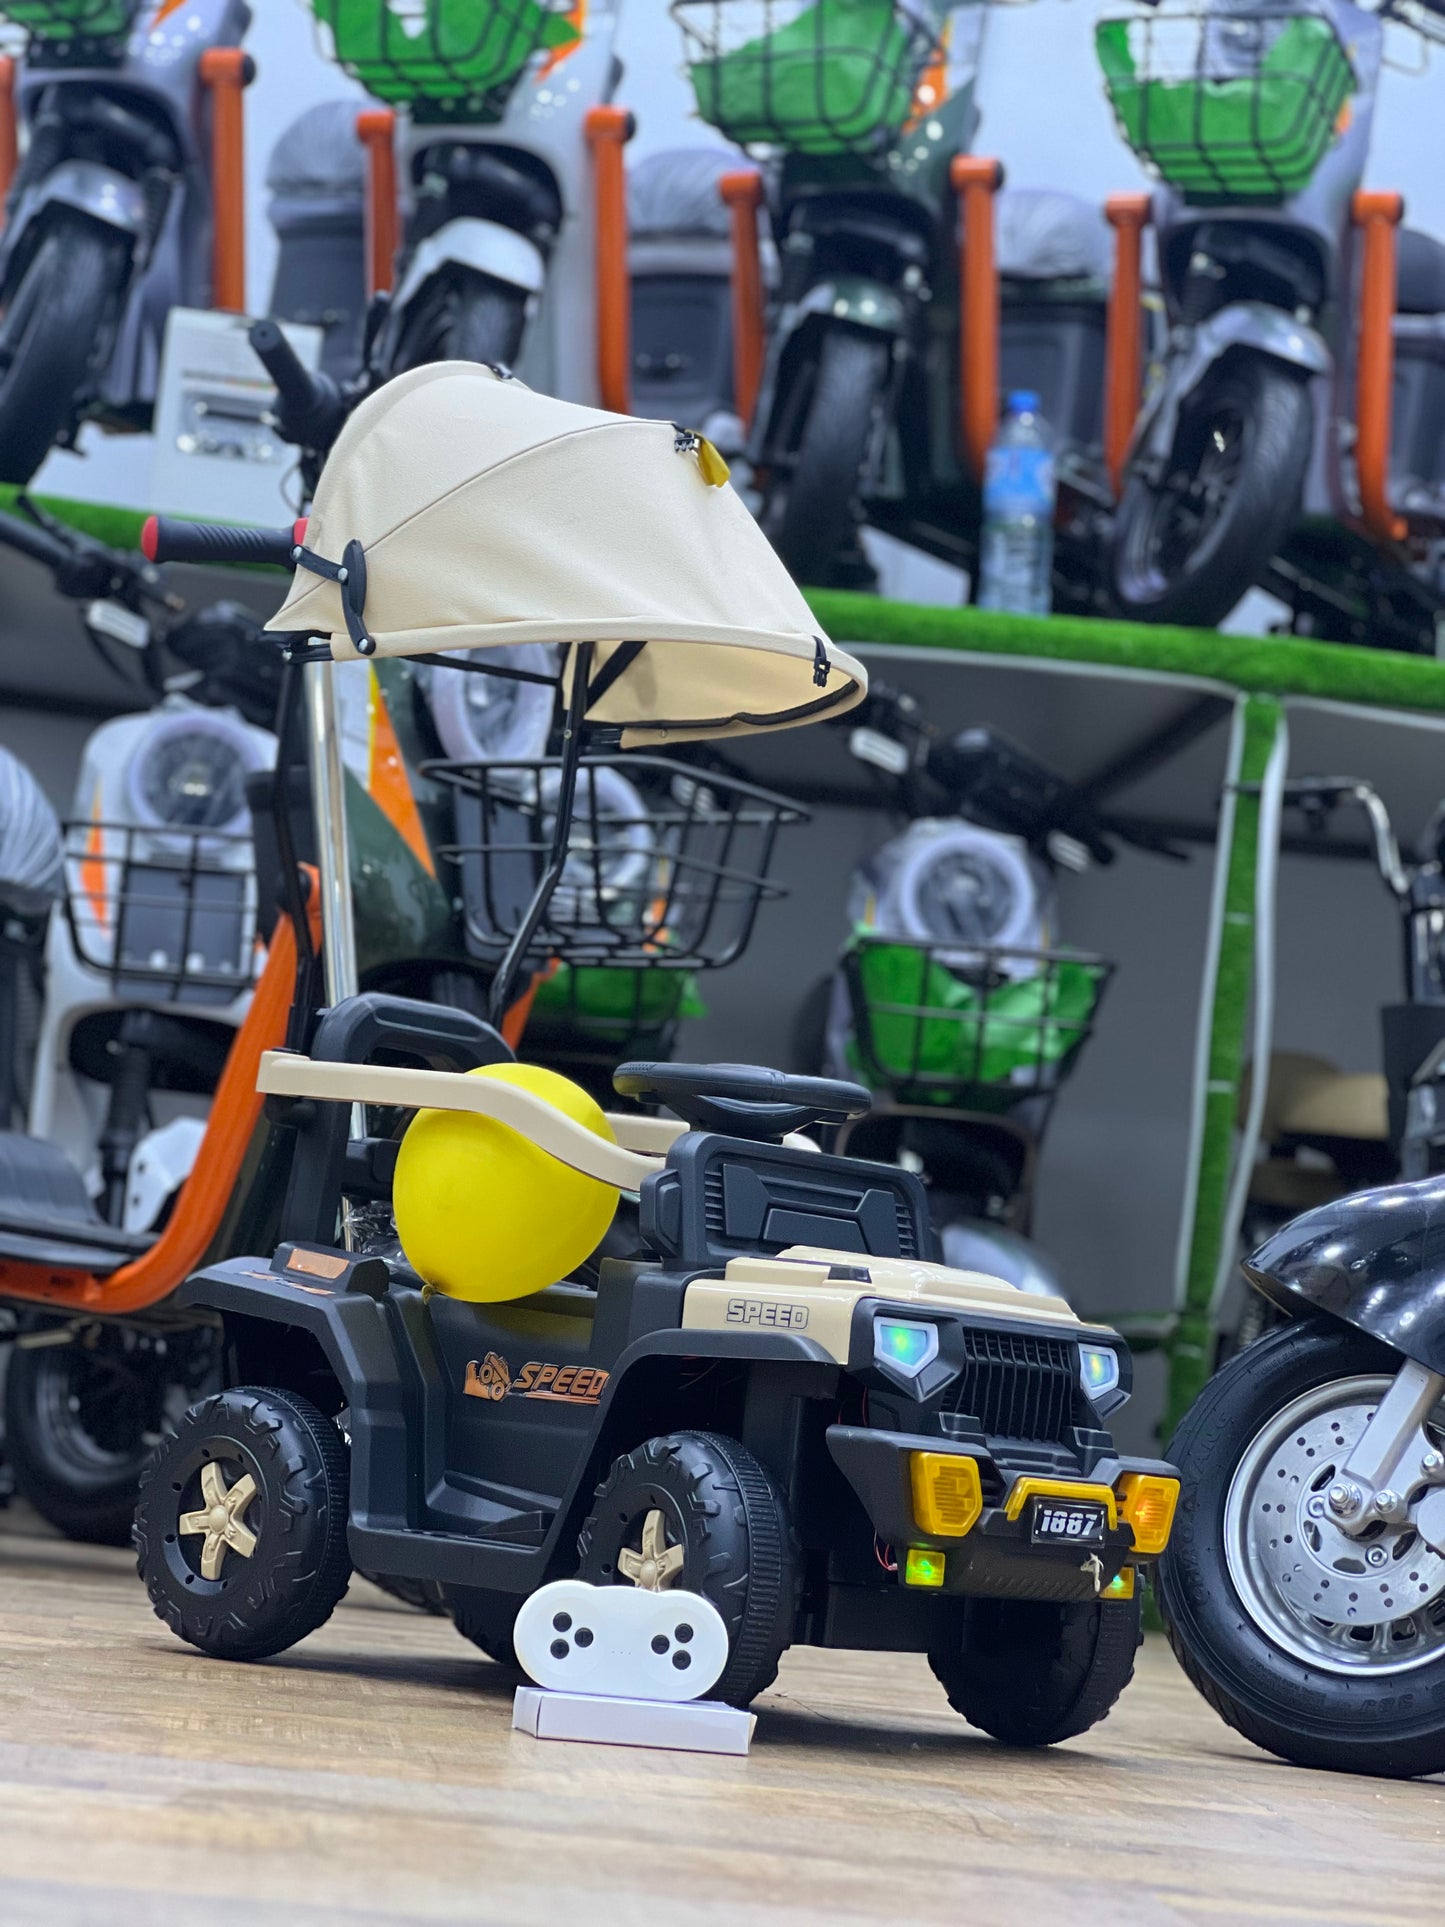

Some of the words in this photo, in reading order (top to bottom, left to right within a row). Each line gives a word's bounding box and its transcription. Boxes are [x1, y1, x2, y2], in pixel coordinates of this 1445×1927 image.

[726, 1298, 809, 1329] SPEED
[512, 1361, 610, 1396] SPEED
[1041, 1510, 1098, 1535] 1887
